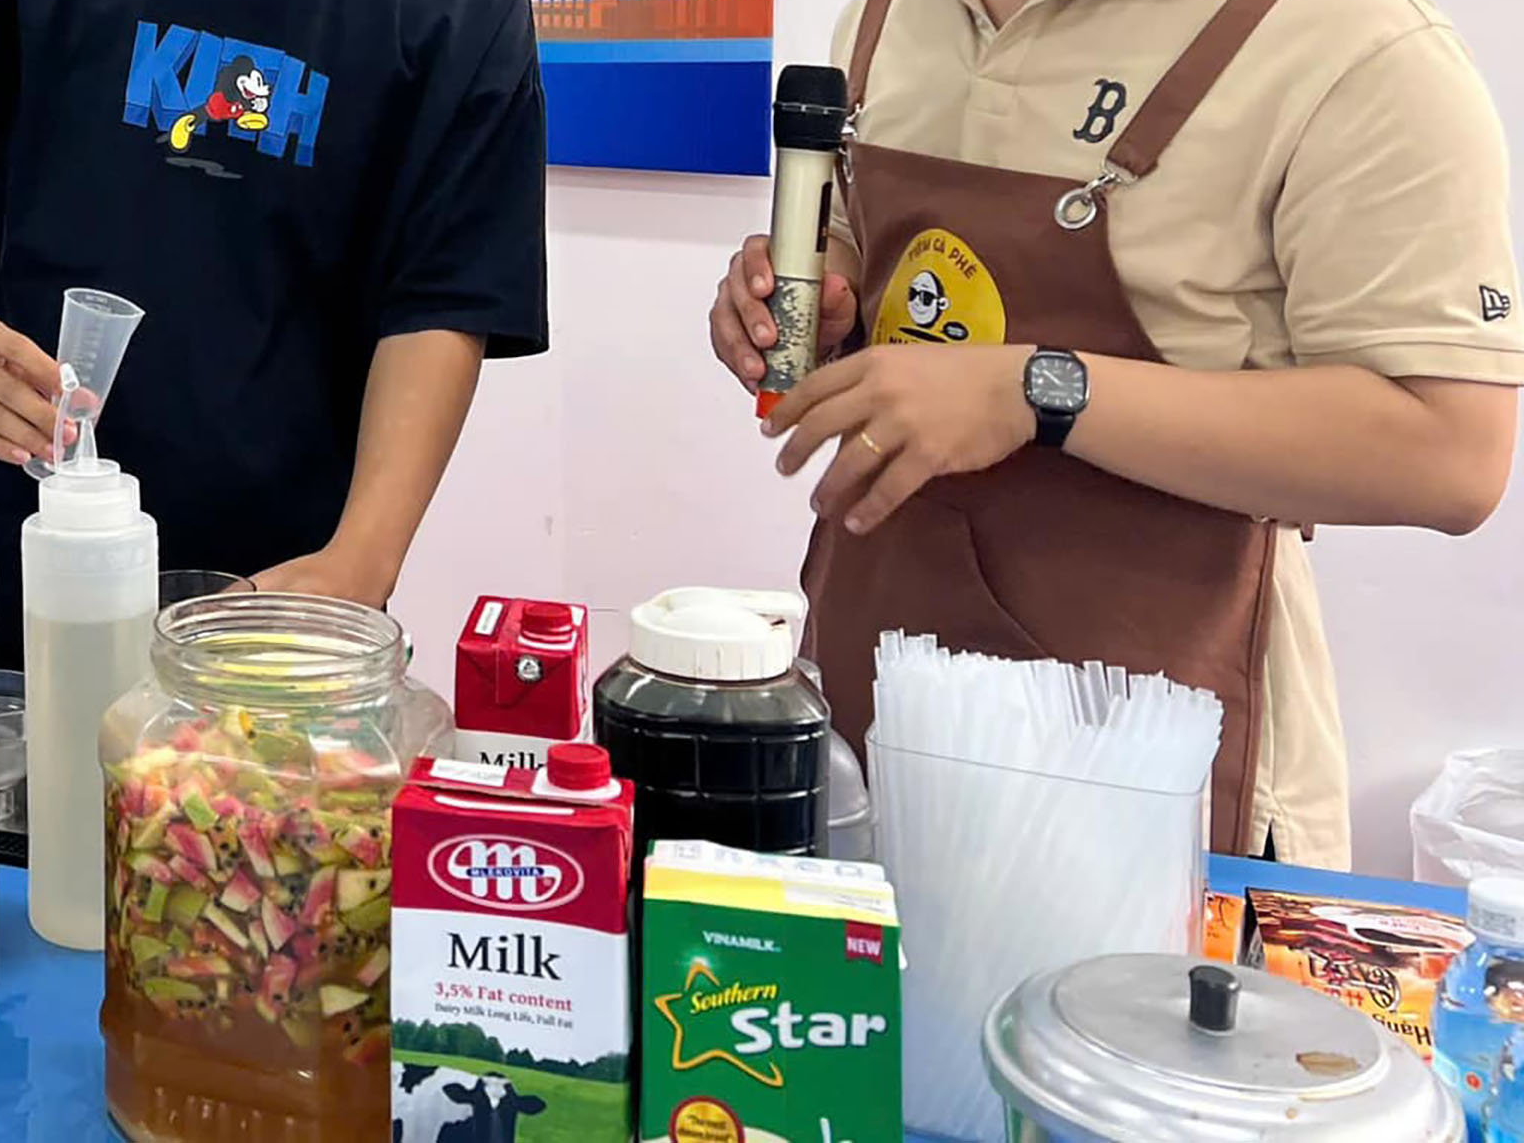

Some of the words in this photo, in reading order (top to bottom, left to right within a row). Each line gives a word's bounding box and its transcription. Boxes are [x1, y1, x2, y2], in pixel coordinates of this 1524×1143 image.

[1072, 78, 1127, 143] B
[447, 932, 562, 981] Milk
[702, 930, 776, 953] VINAMILK
[845, 937, 882, 957] NEW
[477, 985, 503, 1002] Fat
[509, 993, 574, 1013] content
[690, 980, 779, 1015] Southern
[729, 1000, 888, 1055] Star
